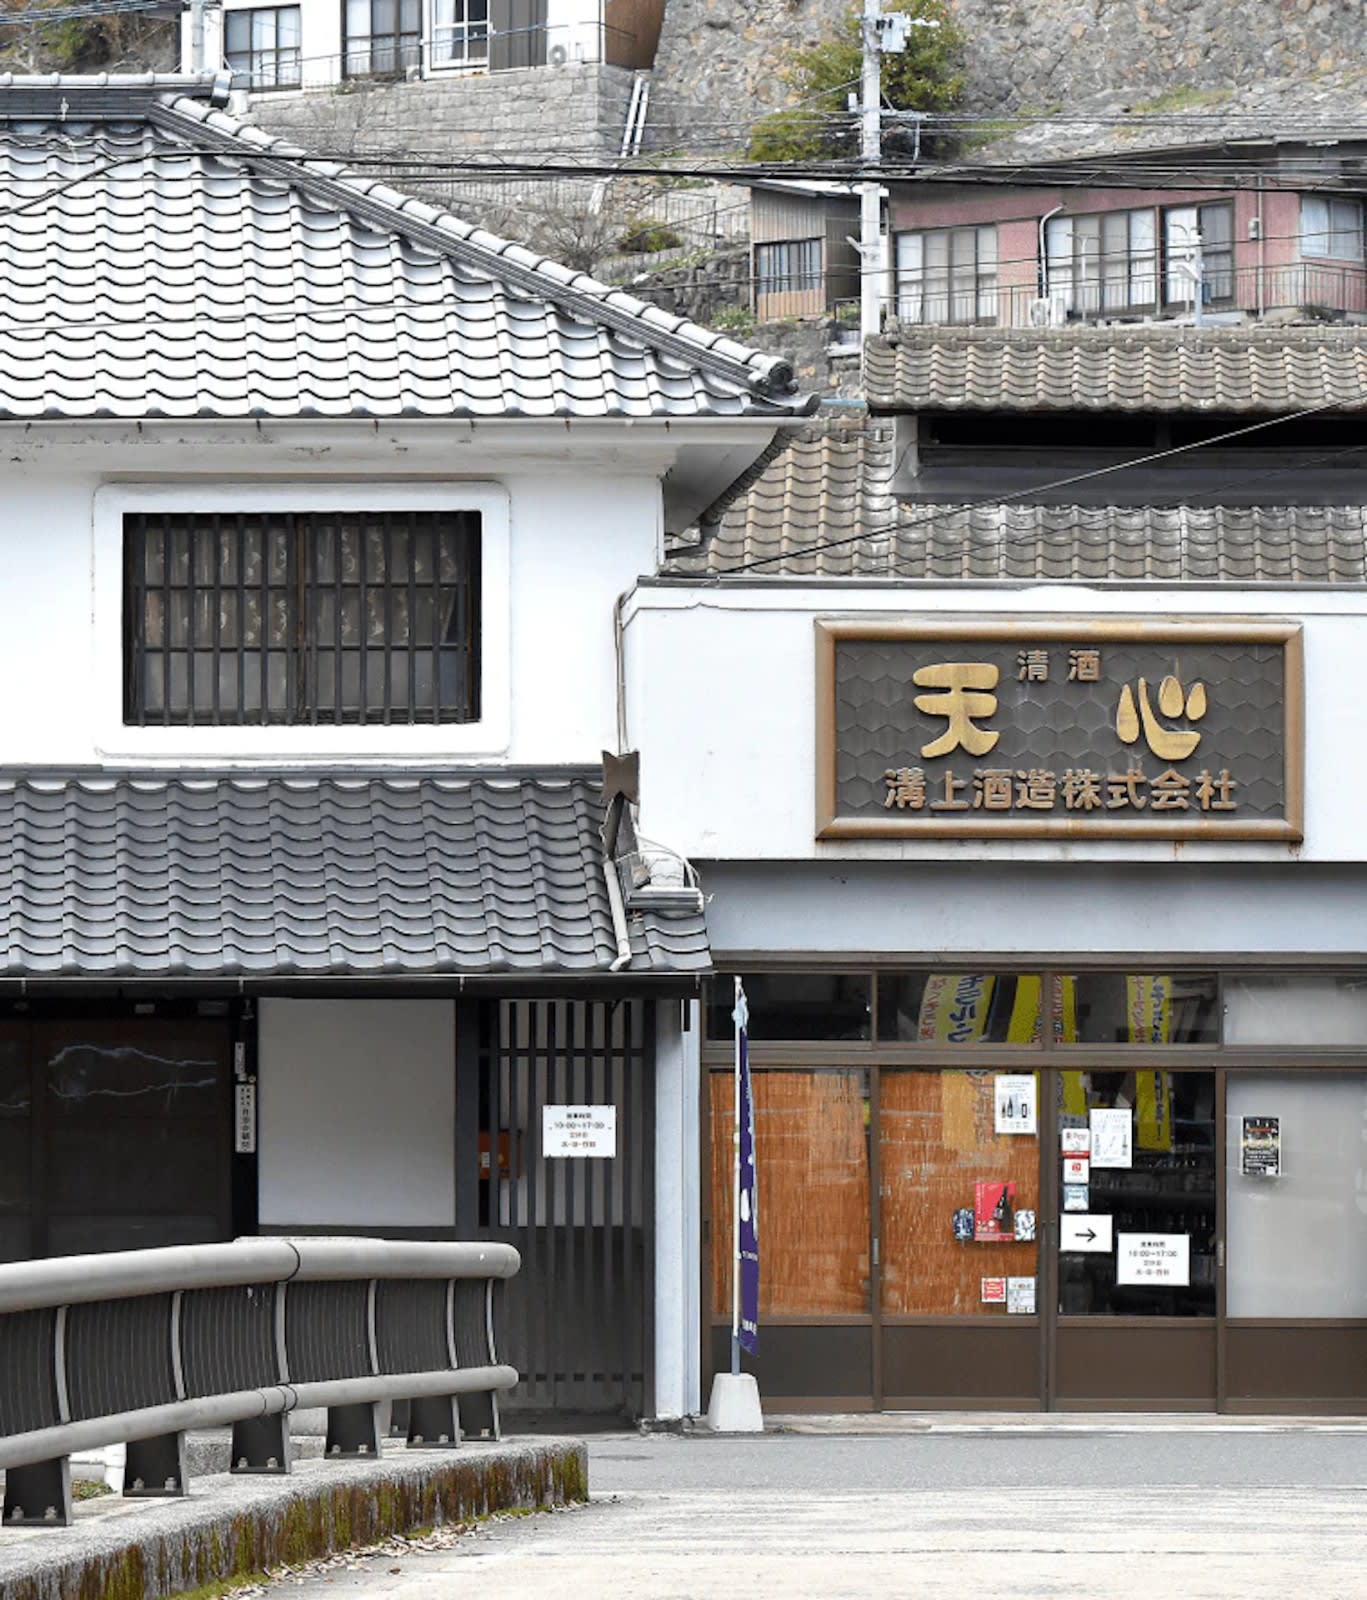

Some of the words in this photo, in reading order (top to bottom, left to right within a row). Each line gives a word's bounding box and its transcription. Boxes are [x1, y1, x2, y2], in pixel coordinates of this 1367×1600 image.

[1017, 648, 1101, 682] 清酒
[912, 661, 1208, 761] 天心
[883, 766, 1239, 812] 溝上酒造株式会社
